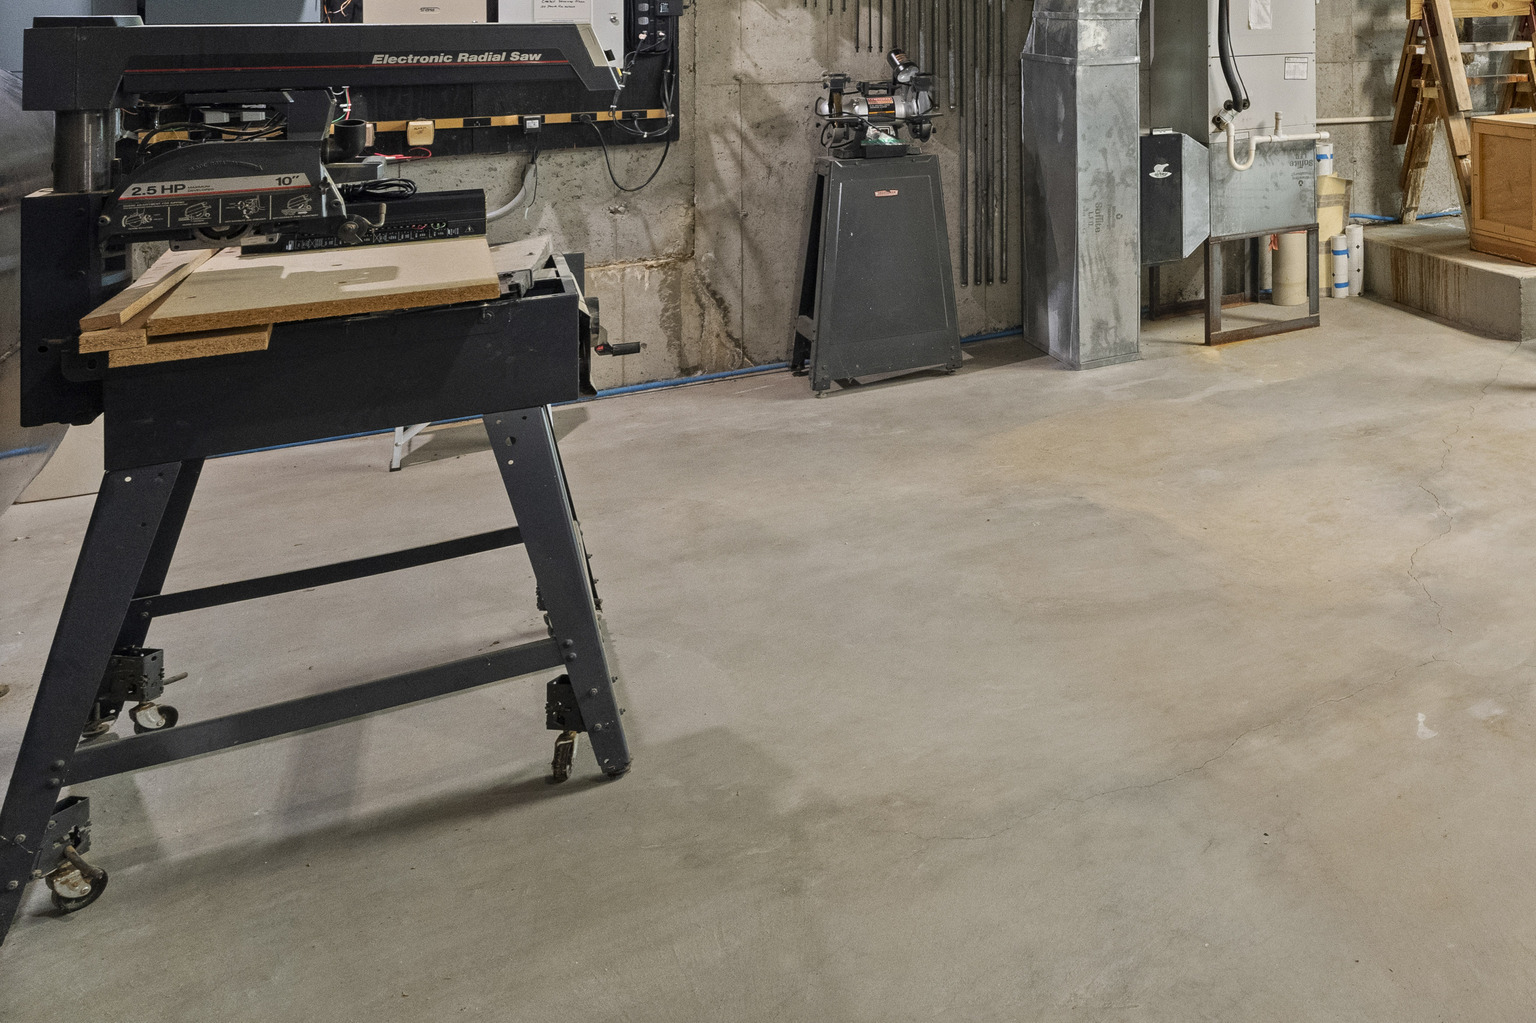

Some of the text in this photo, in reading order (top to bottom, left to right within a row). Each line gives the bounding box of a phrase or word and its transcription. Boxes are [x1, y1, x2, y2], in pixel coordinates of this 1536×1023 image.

[372, 51, 542, 65] Electronic Radial Saw
[131, 184, 186, 196] 2.5 HP
